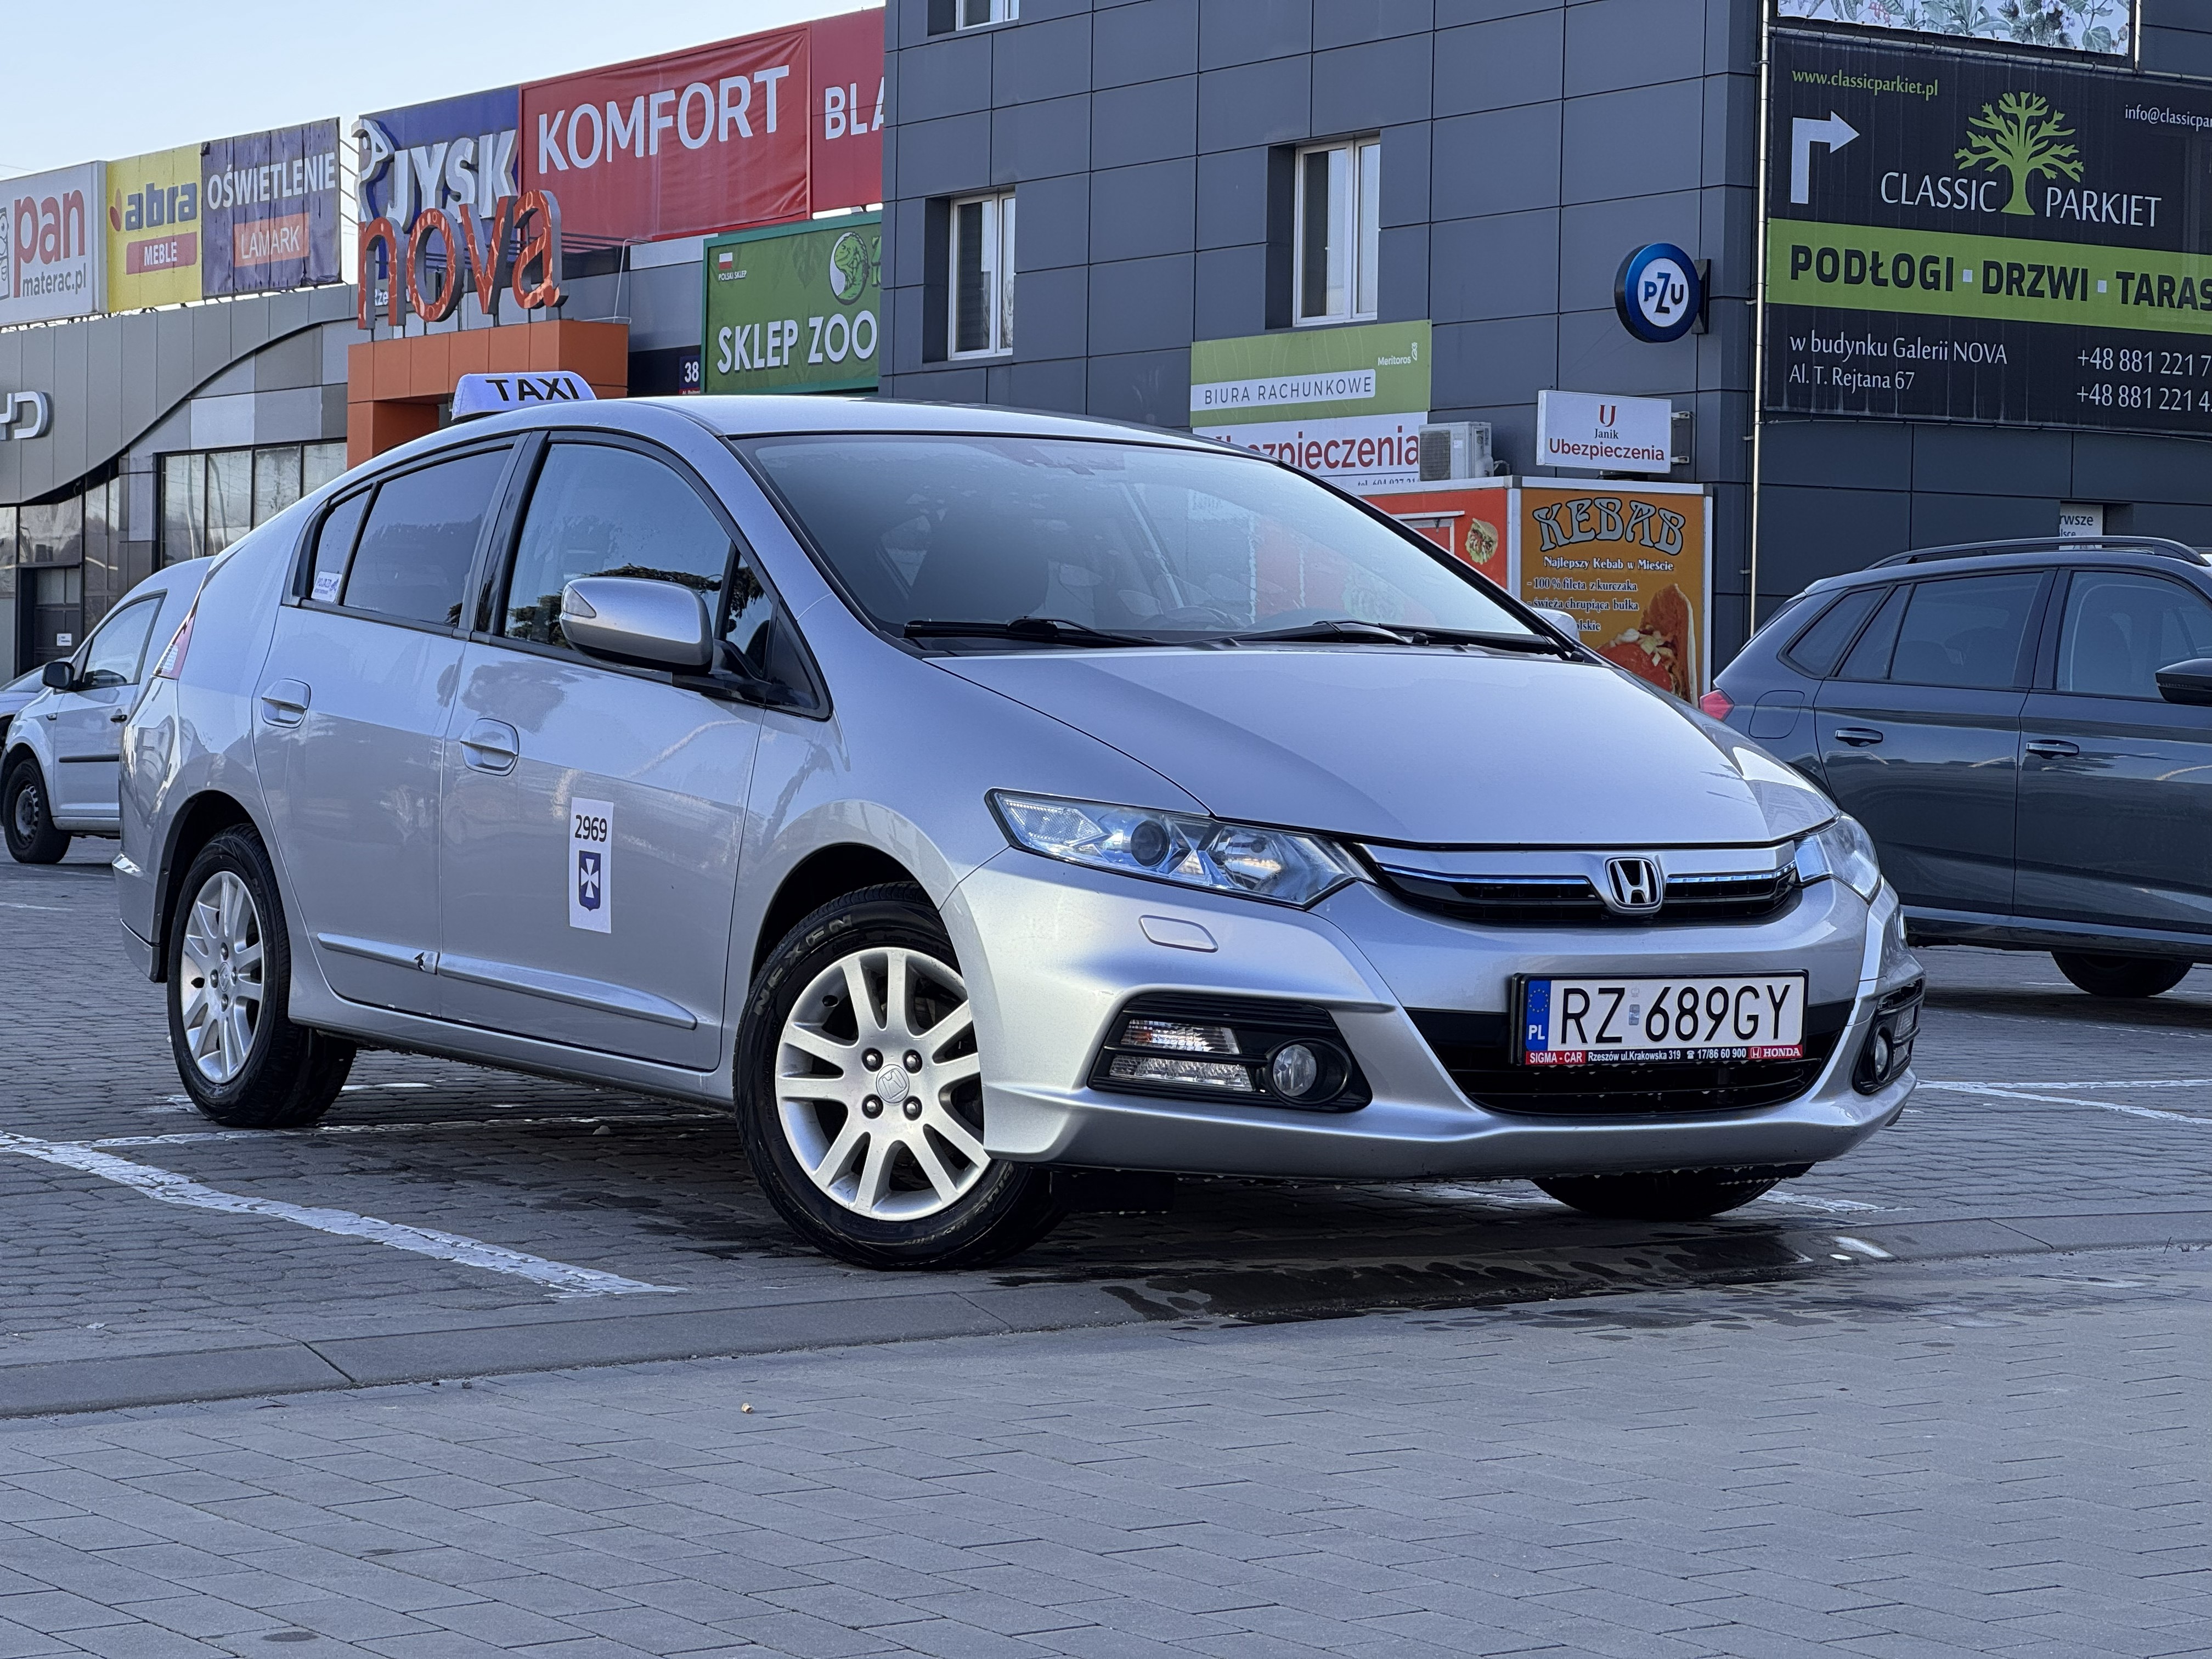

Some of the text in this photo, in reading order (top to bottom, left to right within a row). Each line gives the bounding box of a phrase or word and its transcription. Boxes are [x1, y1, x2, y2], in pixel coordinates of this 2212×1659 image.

[1792, 69, 1938, 100] www.classicparkiet.pl
[538, 65, 789, 174] KOMFORT
[207, 152, 335, 210] OŚWIETLENIE
[389, 129, 518, 233] JYSK
[125, 182, 198, 232] abra
[1881, 171, 2162, 228] CLASSIC PARKIET
[14, 189, 86, 298] pan
[144, 241, 177, 266] MEBLE
[241, 225, 300, 259] LAMARK
[358, 189, 568, 329] nova
[1790, 245, 1954, 292] PODŁOGI
[1982, 260, 2088, 302] DRZWI
[23, 263, 86, 297] materac.pl
[718, 270, 747, 281] POLSKI SKLEP
[1644, 272, 1684, 314] PZU
[717, 310, 877, 374] SKLEP ZOO
[1790, 330, 2008, 365] w budynku Galerii NOVA
[684, 361, 699, 383] 38
[1378, 355, 1412, 366] Meritoros
[2078, 347, 2113, 370] +48
[2119, 349, 2153, 373] 881
[2160, 352, 2193, 376] 221
[485, 377, 580, 402] TAXI
[1205, 376, 1372, 405] BIURA RACHUNKOWE
[1789, 366, 1915, 394] Al. T. Rejtana 67
[2076, 383, 2112, 407] +48
[2118, 385, 2151, 409] 881
[2159, 388, 2192, 411] 221
[1594, 428, 1619, 439] Janik
[1549, 438, 1664, 461] Ubezpieczenia
[1532, 497, 1686, 555] KEBAB
[1544, 556, 1590, 569] Najlepszy
[1593, 557, 1624, 569] Kebab
[1638, 558, 1674, 571] Mieście
[1534, 577, 1551, 589] 100
[1562, 577, 1586, 590] fileta
[1590, 582, 1595, 590] z
[1597, 579, 1638, 591] kurczaka
[1533, 597, 1563, 609] świeża
[1565, 597, 1609, 612] chrupiąca
[1613, 599, 1639, 610] bułka
[574, 814, 607, 843] 2969
[1561, 984, 1791, 1045] RZ 689GY
[1528, 1024, 1545, 1041] PL
[1530, 1052, 1557, 1063] SIGMA
[1564, 1052, 1583, 1062] CAR
[1588, 1051, 1619, 1062] Rzeszów
[1669, 1050, 1681, 1060] 319
[1697, 1049, 1719, 1059] 17/86
[1720, 1048, 1730, 1058] 60
[1732, 1048, 1746, 1058] 900
[1763, 1046, 1801, 1057] HONDA
